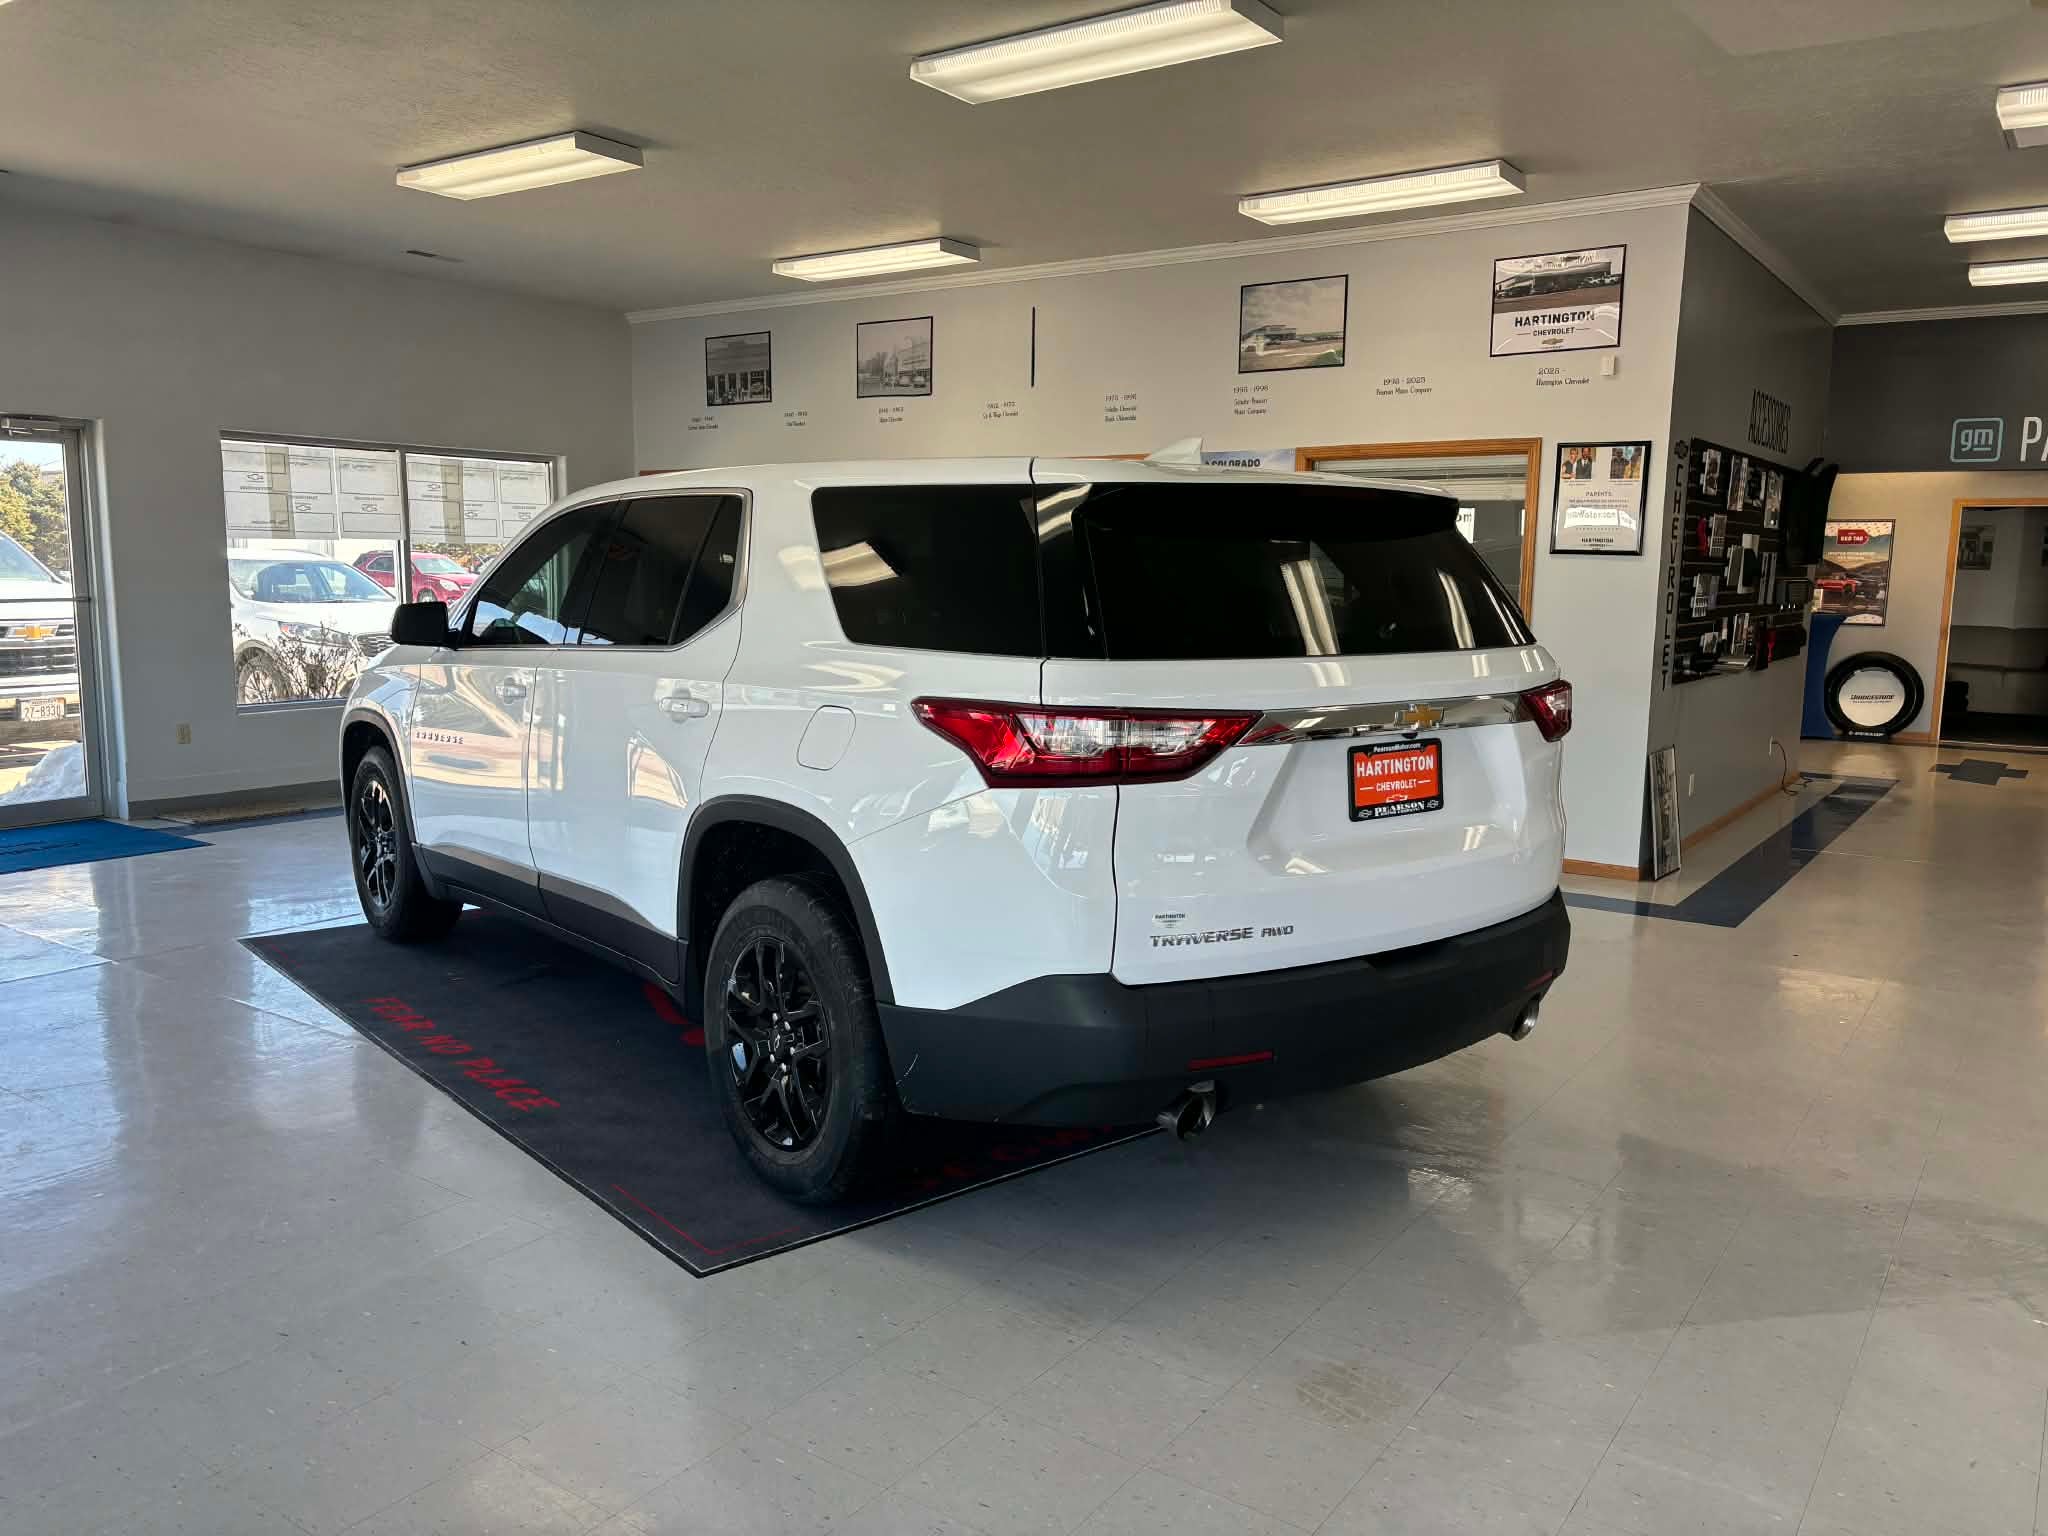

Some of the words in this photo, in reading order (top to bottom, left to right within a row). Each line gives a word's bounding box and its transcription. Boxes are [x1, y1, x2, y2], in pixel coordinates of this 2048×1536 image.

[1514, 311, 1595, 327] HARTINGTON
[1532, 326, 1576, 337] CHEVROLET
[1960, 428, 1994, 451] gm
[1661, 463, 1684, 692] CHEVROLET
[1356, 755, 1434, 777] HARTINGTON
[1376, 779, 1417, 792] CHEVROLET
[1374, 801, 1426, 816] PEARSON
[1150, 927, 1254, 947] TRAVERSE
[1261, 925, 1294, 938] AWD
